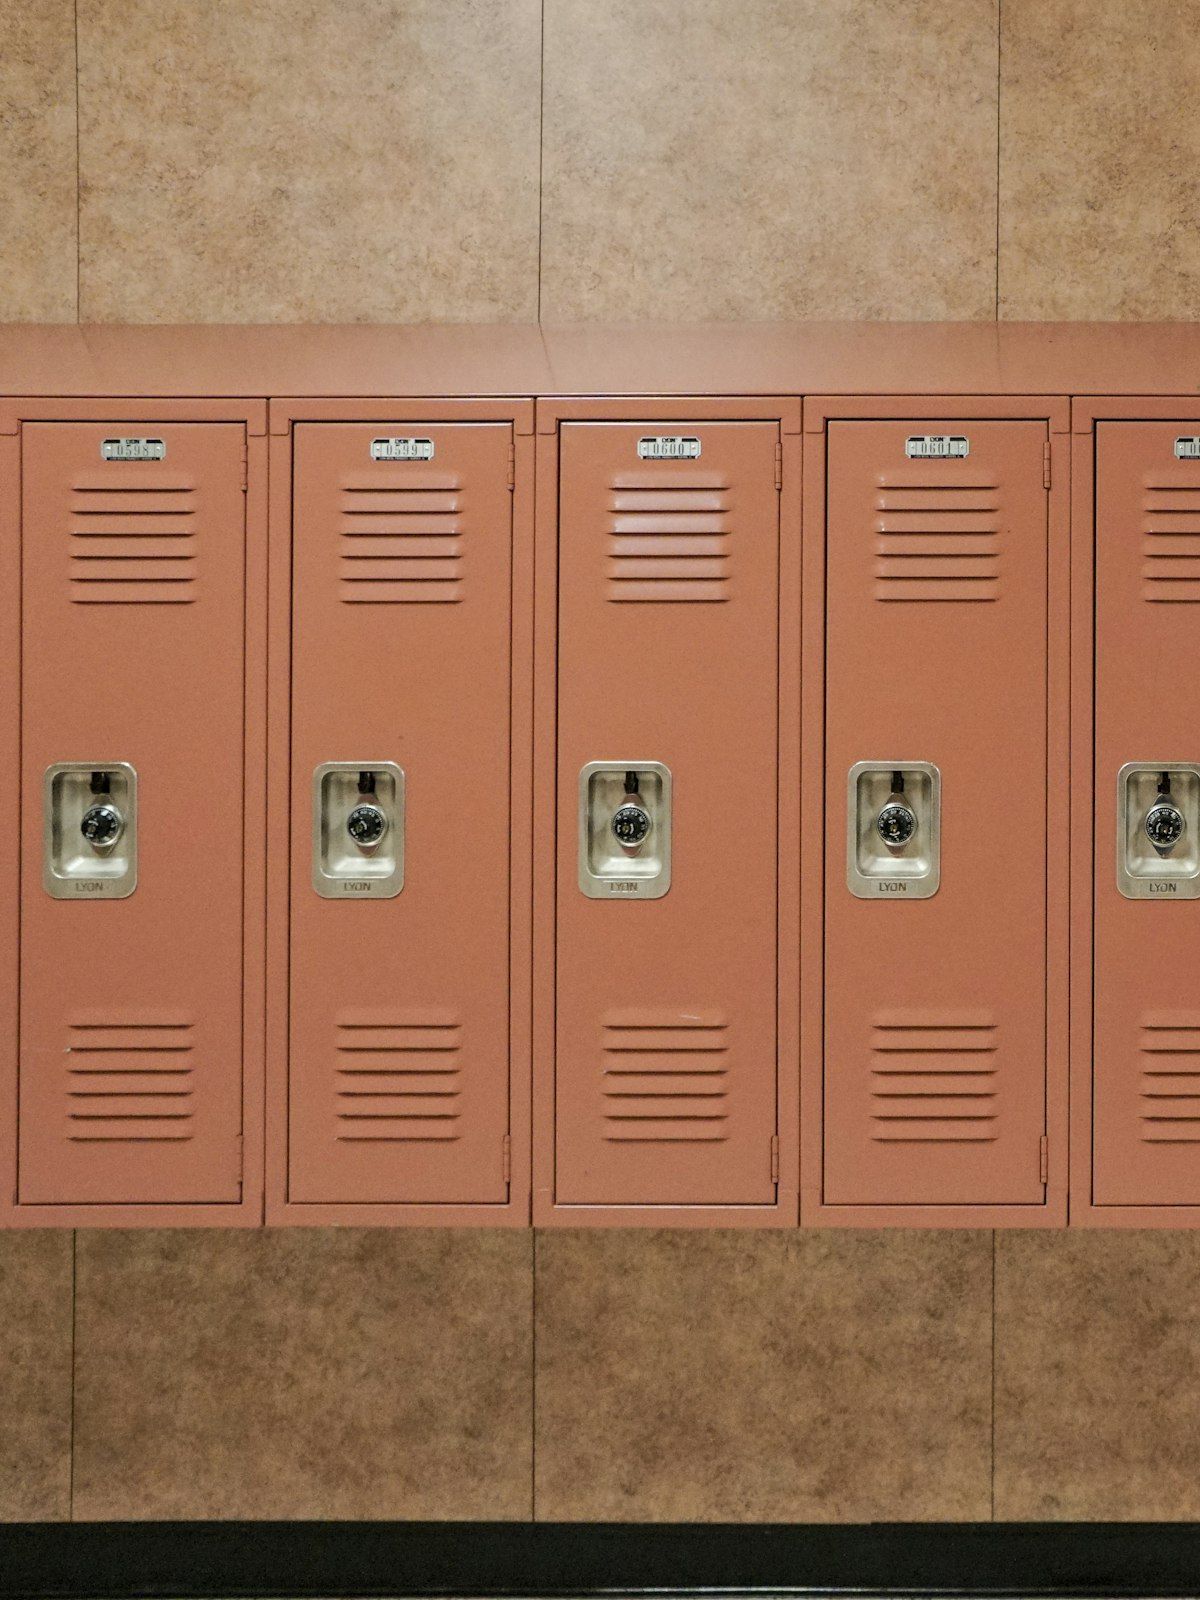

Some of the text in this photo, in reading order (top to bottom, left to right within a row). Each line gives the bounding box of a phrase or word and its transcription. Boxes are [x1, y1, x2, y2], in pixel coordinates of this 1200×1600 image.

[117, 444, 149, 456] 0598
[387, 444, 417, 456] 0599
[653, 443, 684, 455] 0600
[921, 442, 951, 454] 0601
[75, 882, 104, 892] LYON
[344, 882, 371, 892] LYON
[610, 882, 638, 892] LYON
[879, 882, 907, 892] LYON
[1149, 882, 1177, 893] LYON
